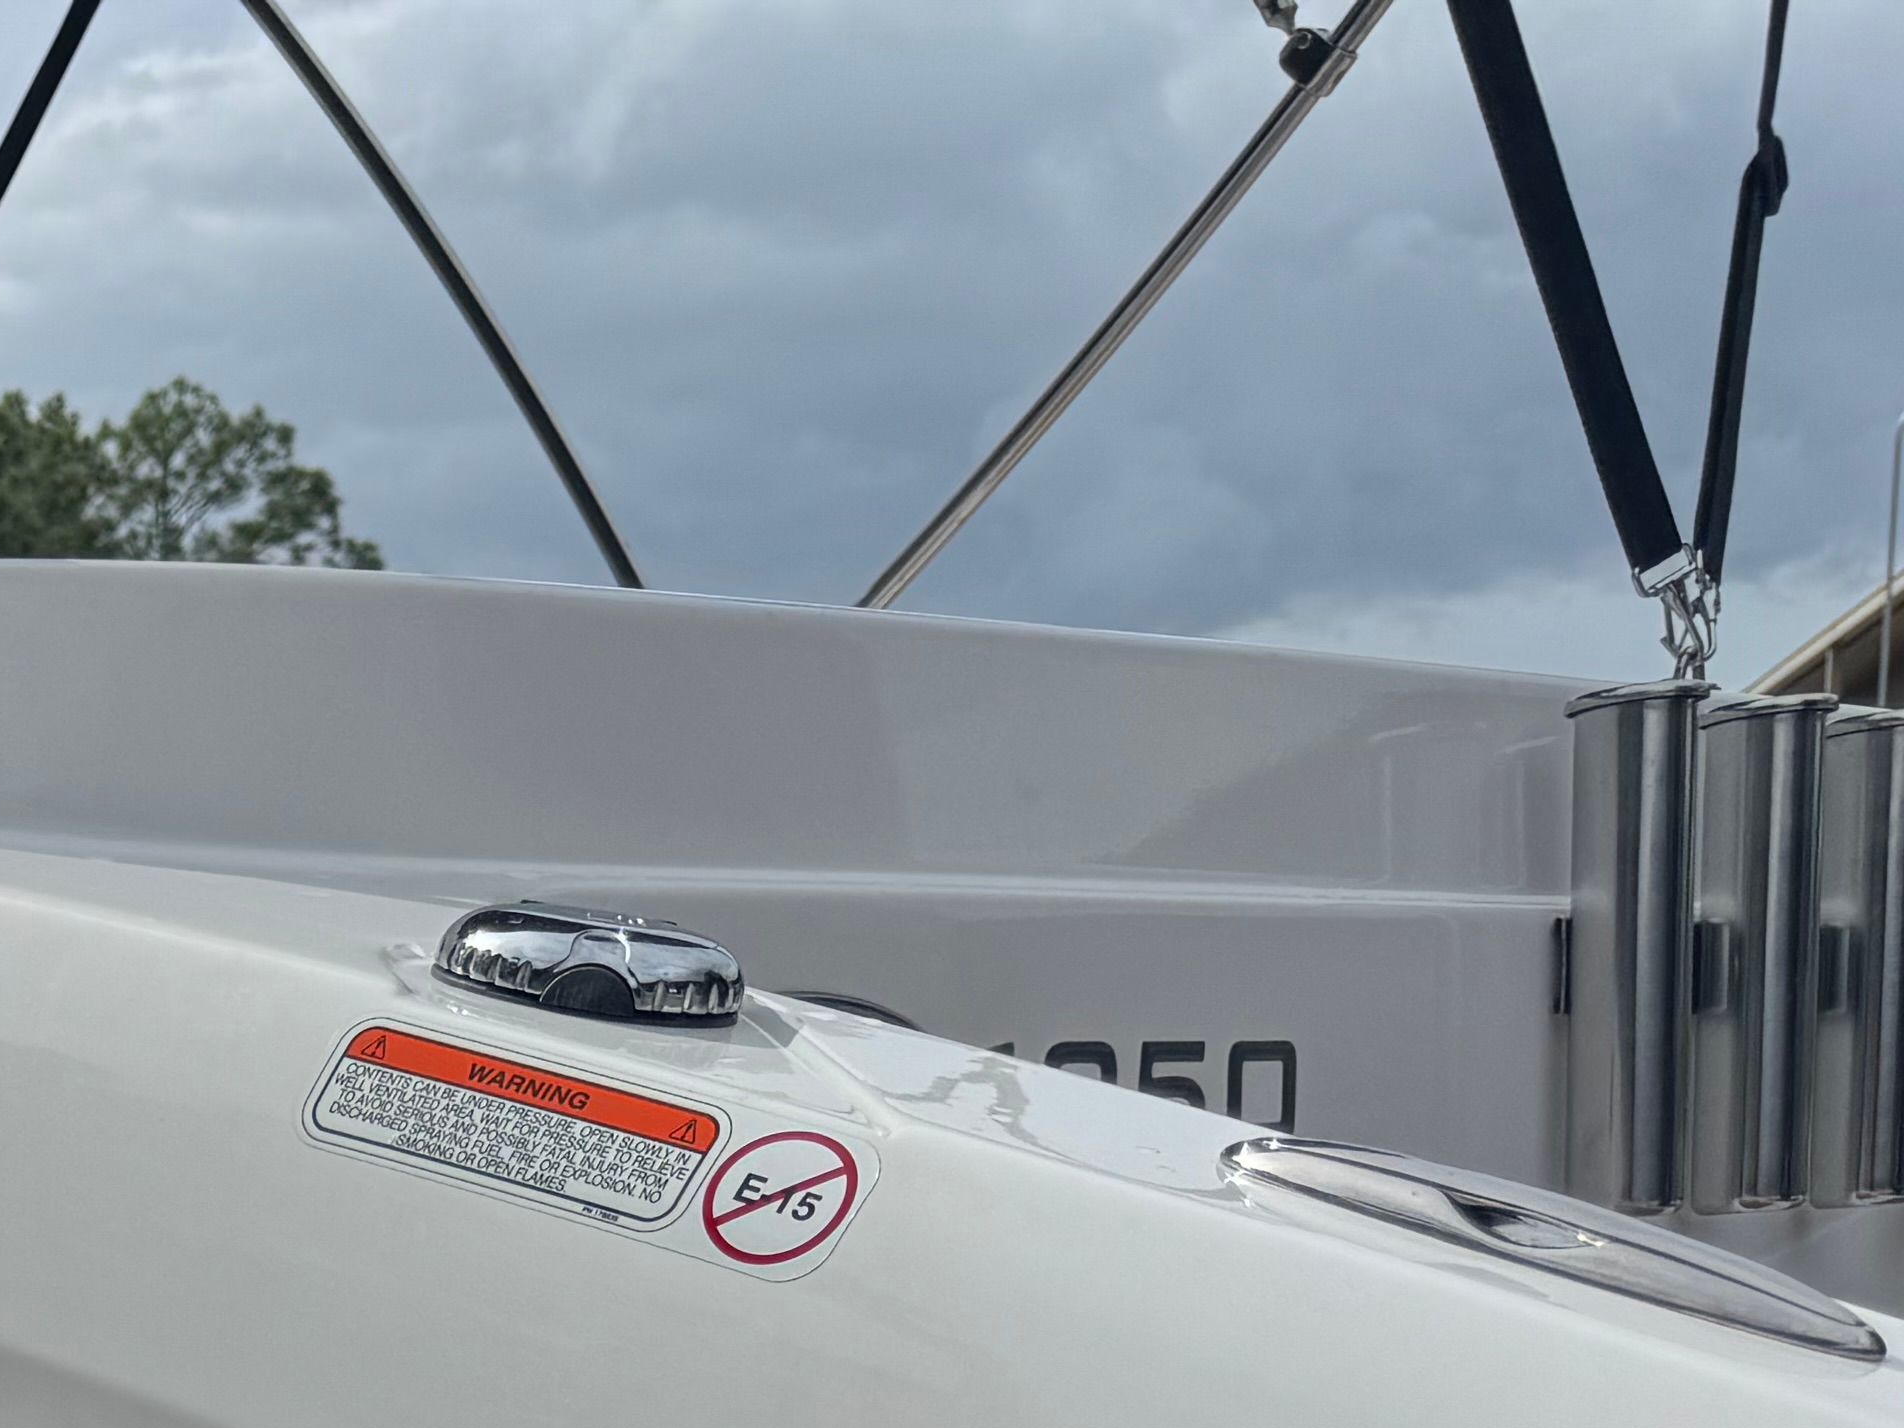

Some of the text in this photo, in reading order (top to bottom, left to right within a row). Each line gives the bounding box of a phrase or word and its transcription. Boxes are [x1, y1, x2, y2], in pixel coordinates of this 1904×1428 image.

[335, 1073, 366, 1092] WELL
[369, 1082, 440, 1111] VENTILATED
[480, 1112, 512, 1130] WAIT
[512, 1121, 540, 1138] FOR
[540, 1128, 612, 1159] PRESSURE
[614, 1148, 632, 1164] TO
[632, 1155, 690, 1181] RELIEVE
[346, 1062, 691, 1165] CONTENTS CAN BE UNDER PRESSURE. OPEN SLOWLY IN
[468, 1063, 590, 1110] WARNING
[988, 1040, 1297, 1135] 50
[329, 1101, 409, 1132] DISCHARGED
[409, 1122, 470, 1149] SPRAYING
[508, 1150, 539, 1169] FIRE
[540, 1158, 561, 1174] OR
[561, 1164, 635, 1197] EXPLOSION.
[638, 1188, 662, 1204] NO
[339, 1088, 669, 1191] TO AVOID SERIOUS AND POSSIBLY FATAL INJURY FROM
[395, 1133, 568, 1193] SMOKING OR OPEN FLAMES.
